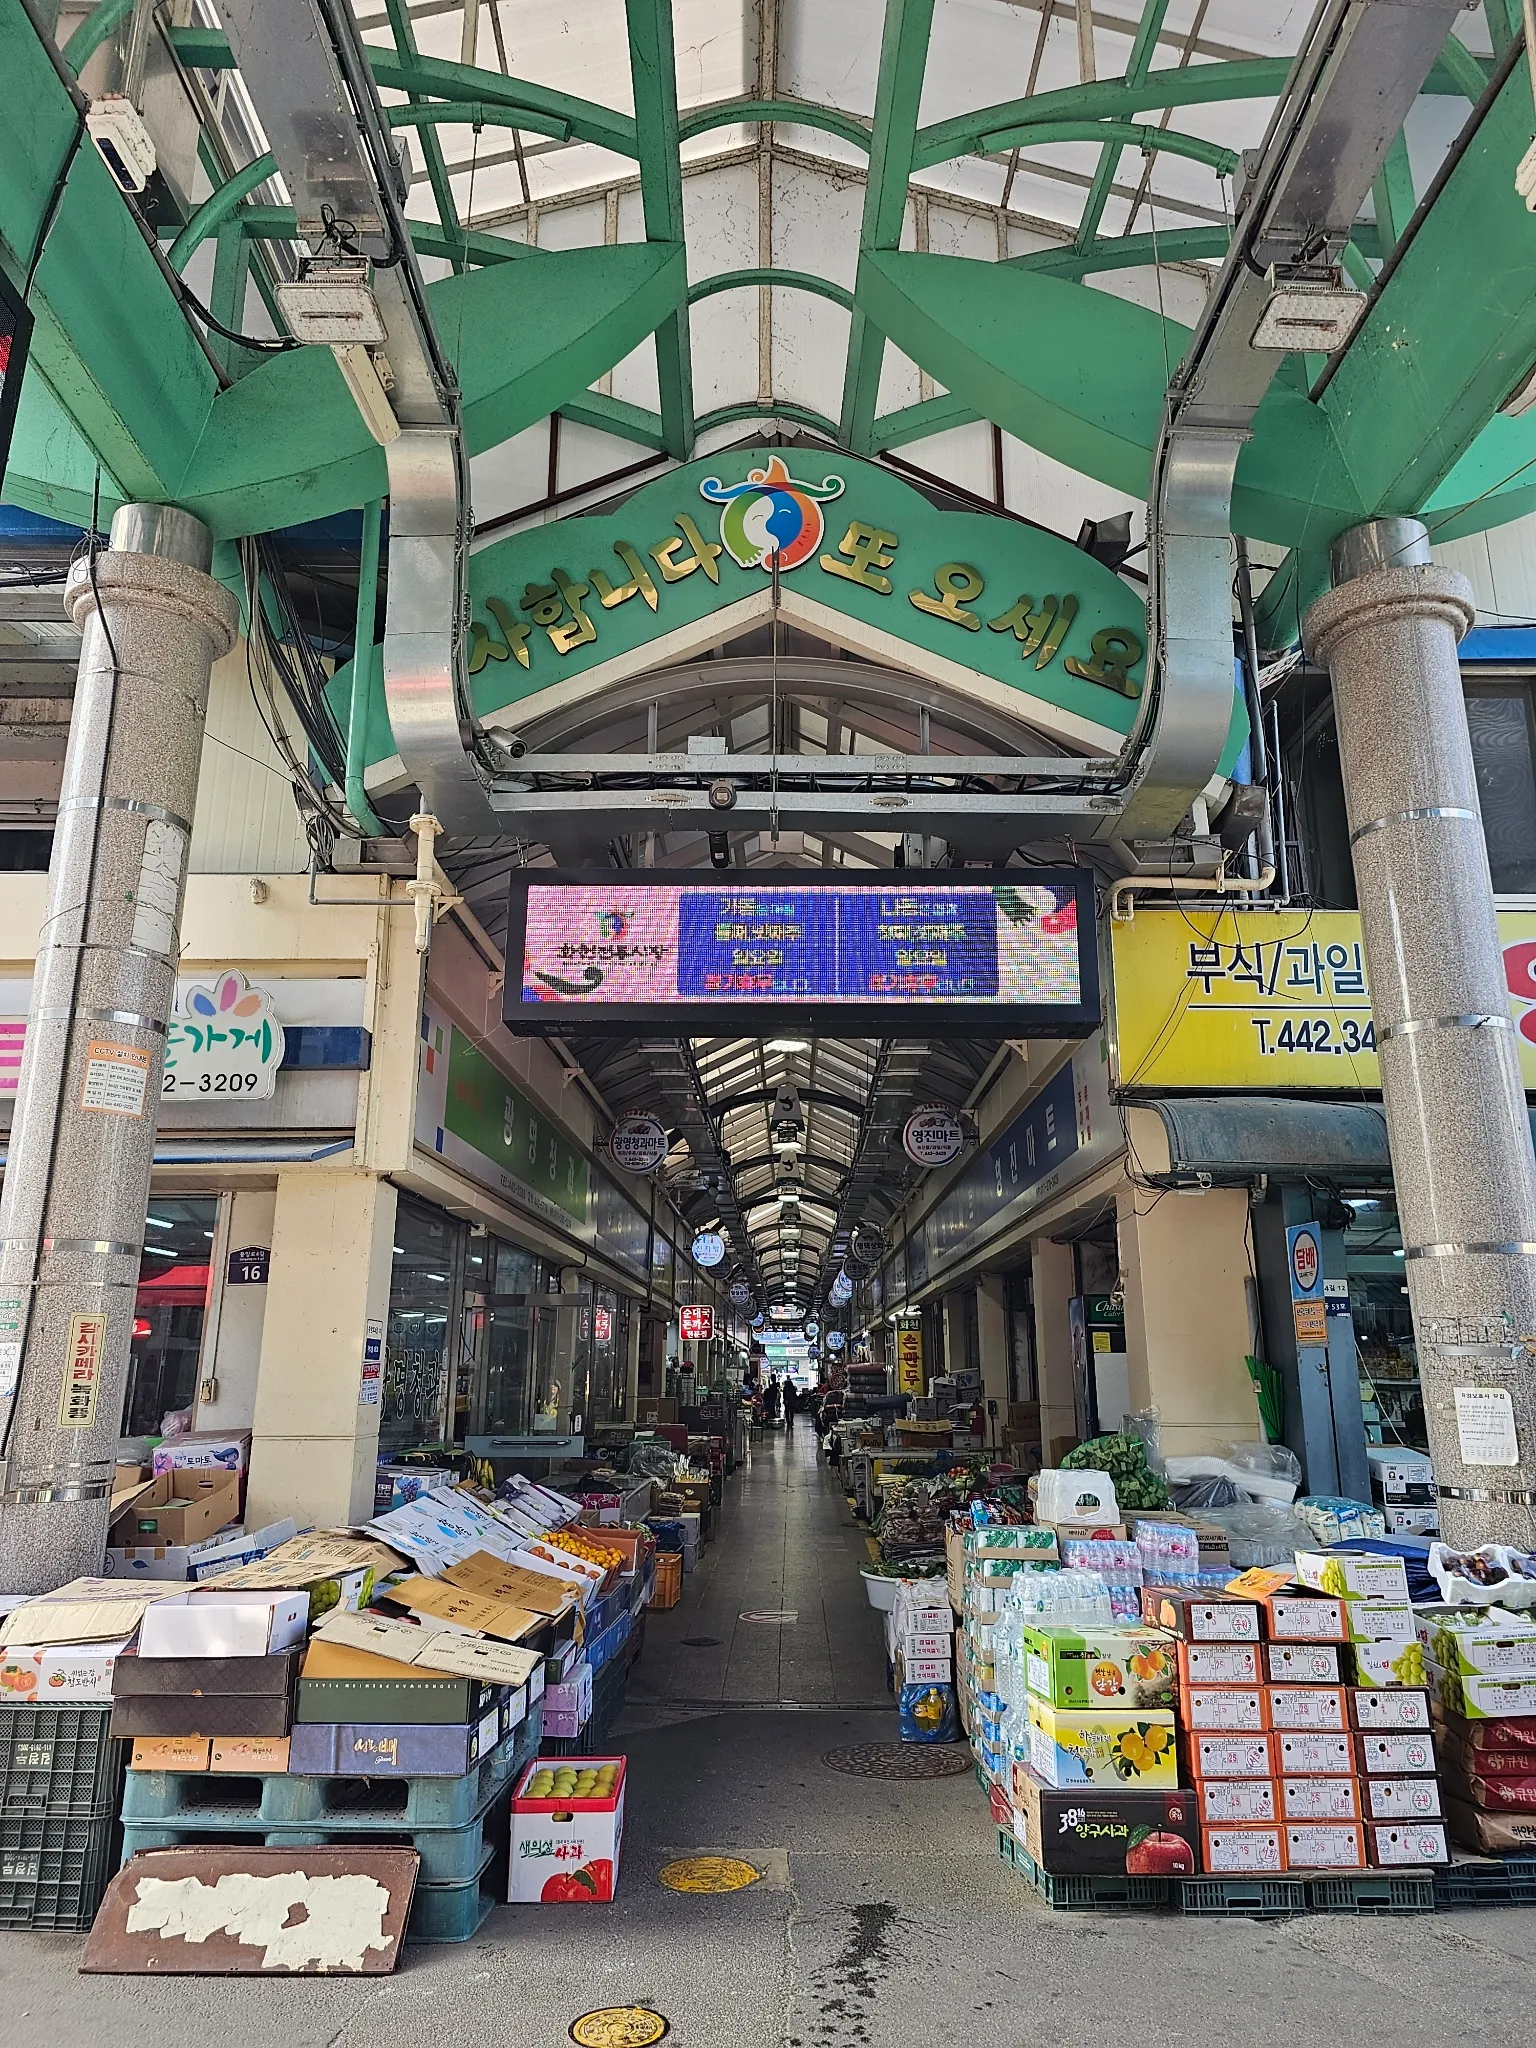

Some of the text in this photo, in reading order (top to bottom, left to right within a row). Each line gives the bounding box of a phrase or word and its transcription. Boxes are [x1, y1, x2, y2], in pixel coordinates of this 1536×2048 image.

[820, 520, 898, 595] 또
[94, 1047, 114, 1056] CCTV
[613, 1136, 666, 1150] 광명청과마트
[911, 1129, 961, 1143] 영진마트
[1295, 1246, 1316, 1270] 담배
[241, 1265, 261, 1280] 16
[682, 1308, 712, 1319] 순대국
[682, 1320, 712, 1330] 돈까스
[67, 1384, 93, 1419] 녹화중
[1505, 1755, 1529, 1769] 큐원
[1075, 1823, 1129, 1839] 양구사과
[519, 1838, 553, 1854] 새의성
[554, 1844, 583, 1861] 사과
